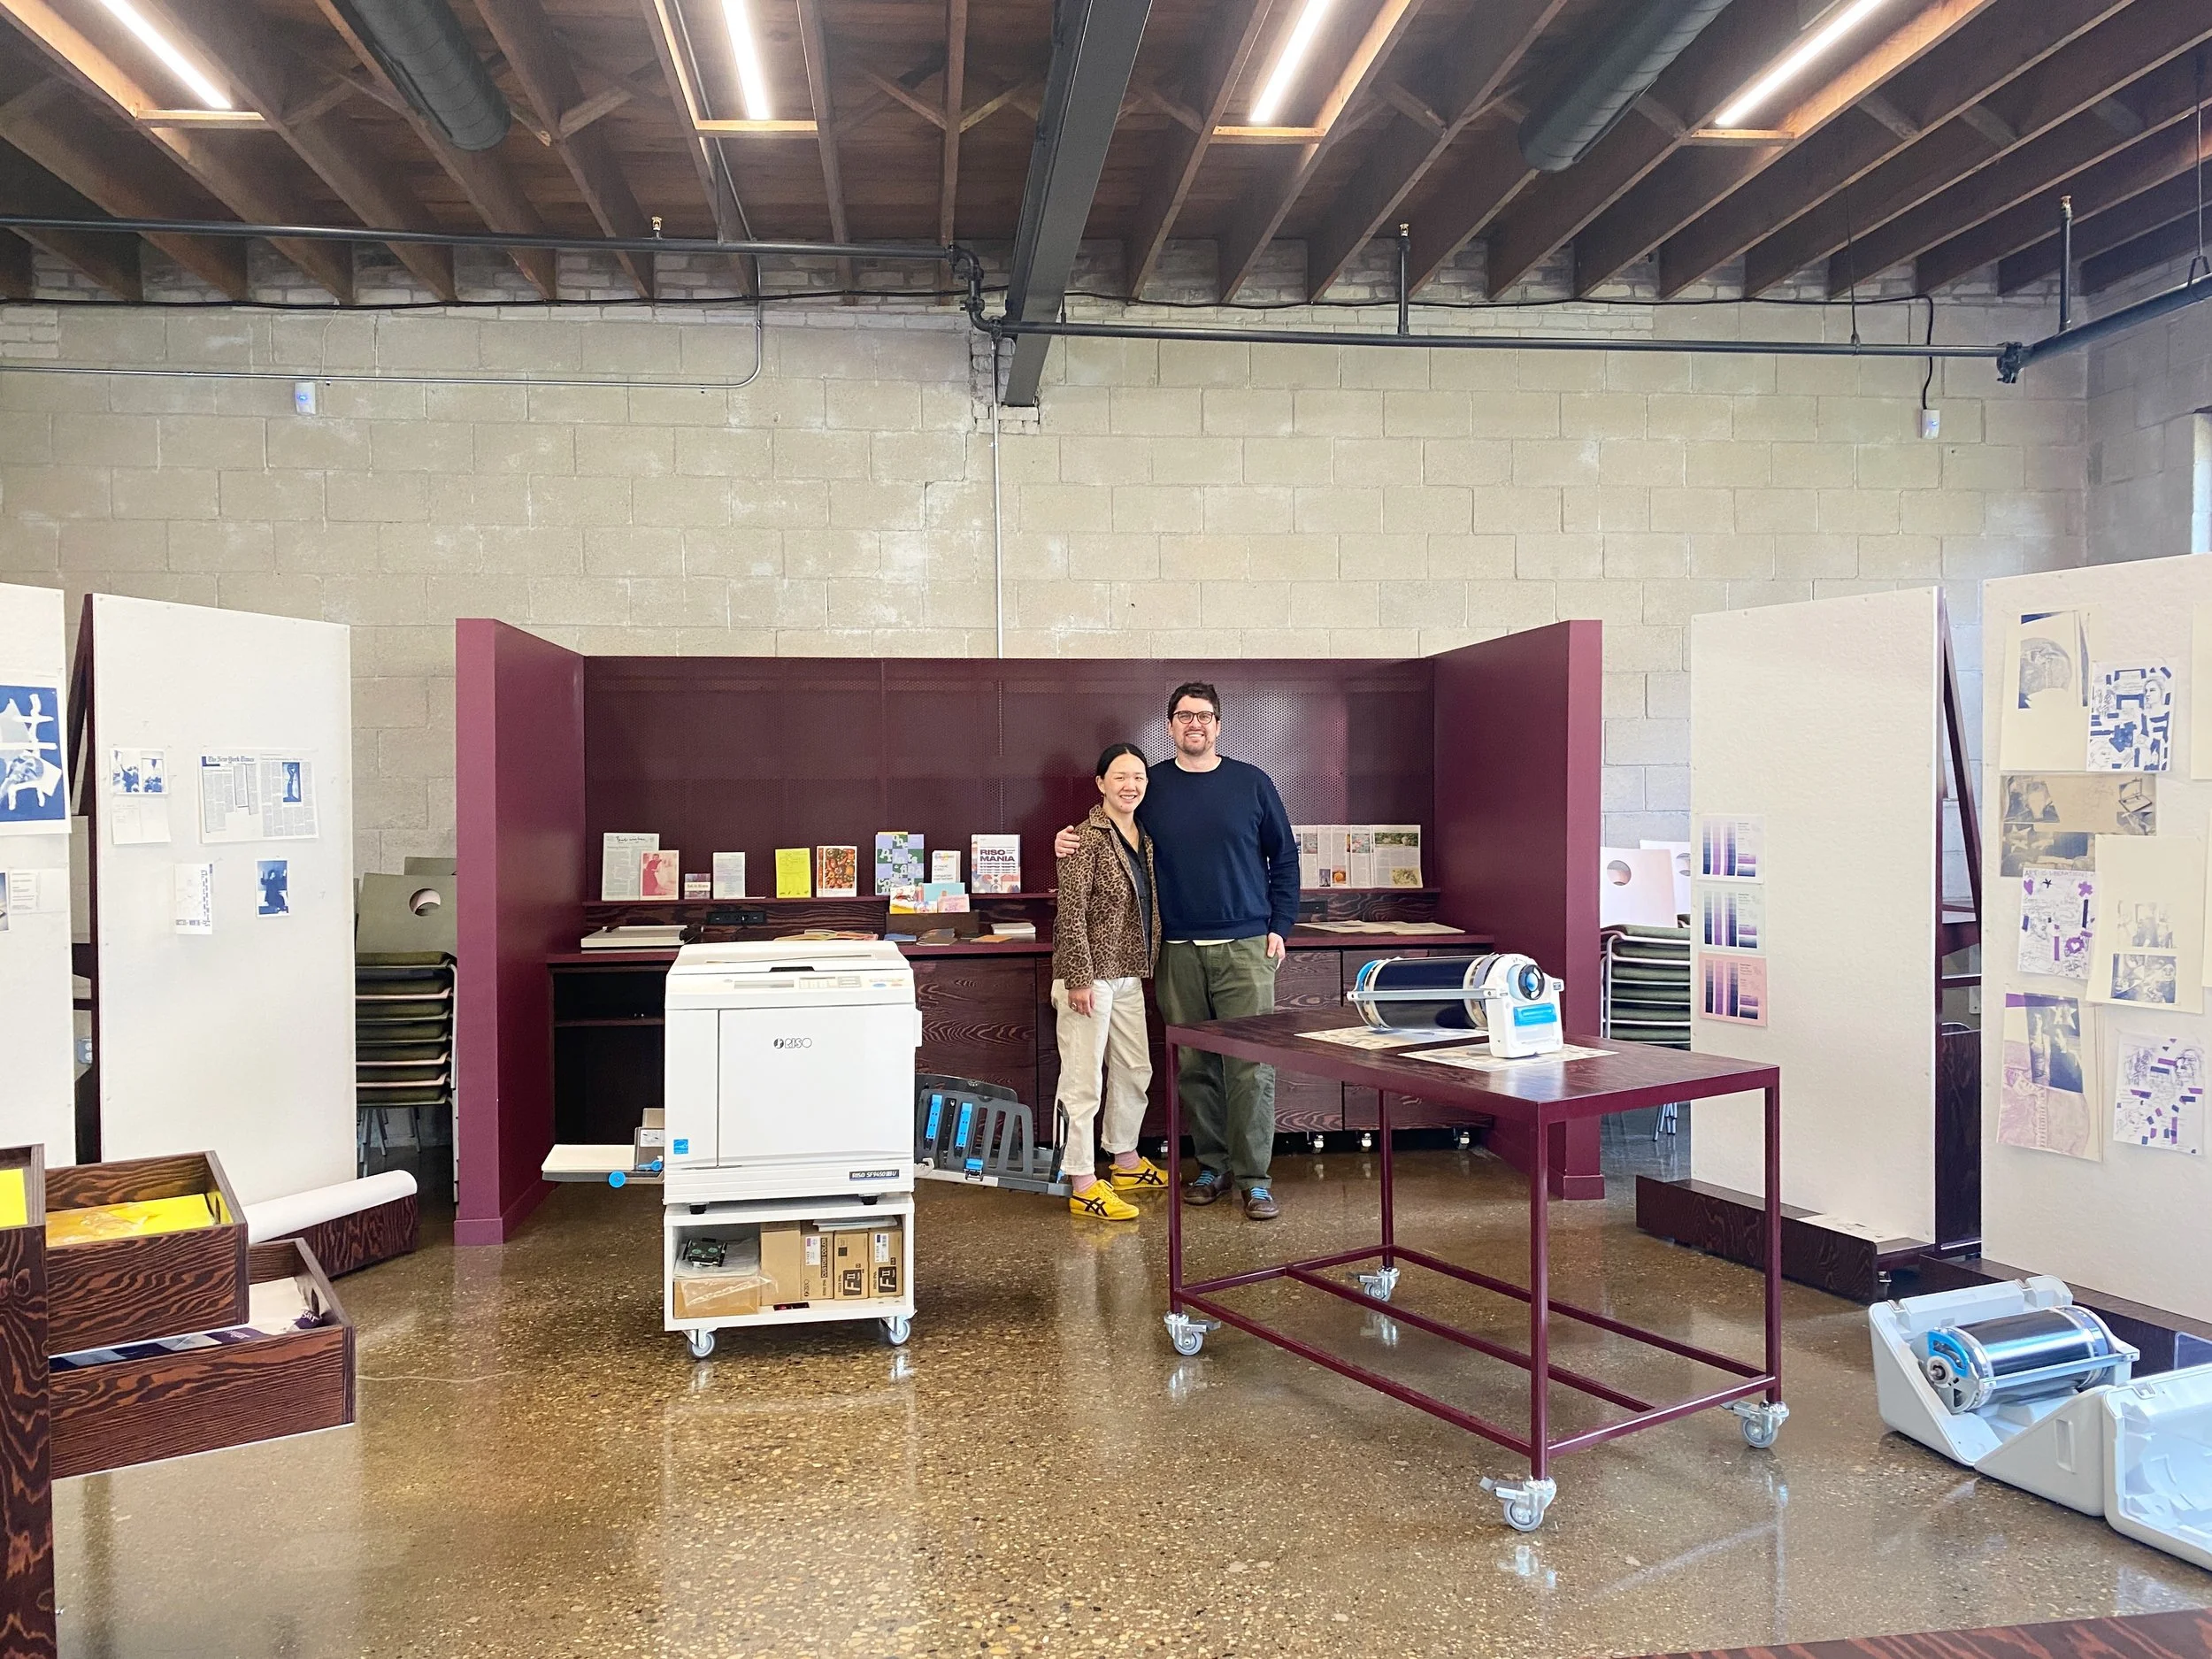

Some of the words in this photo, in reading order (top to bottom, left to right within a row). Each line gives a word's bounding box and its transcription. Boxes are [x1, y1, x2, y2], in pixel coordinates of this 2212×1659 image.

[785, 1037, 812, 1048] RISO
[844, 1279, 861, 1291] F
[879, 1277, 896, 1288] F
